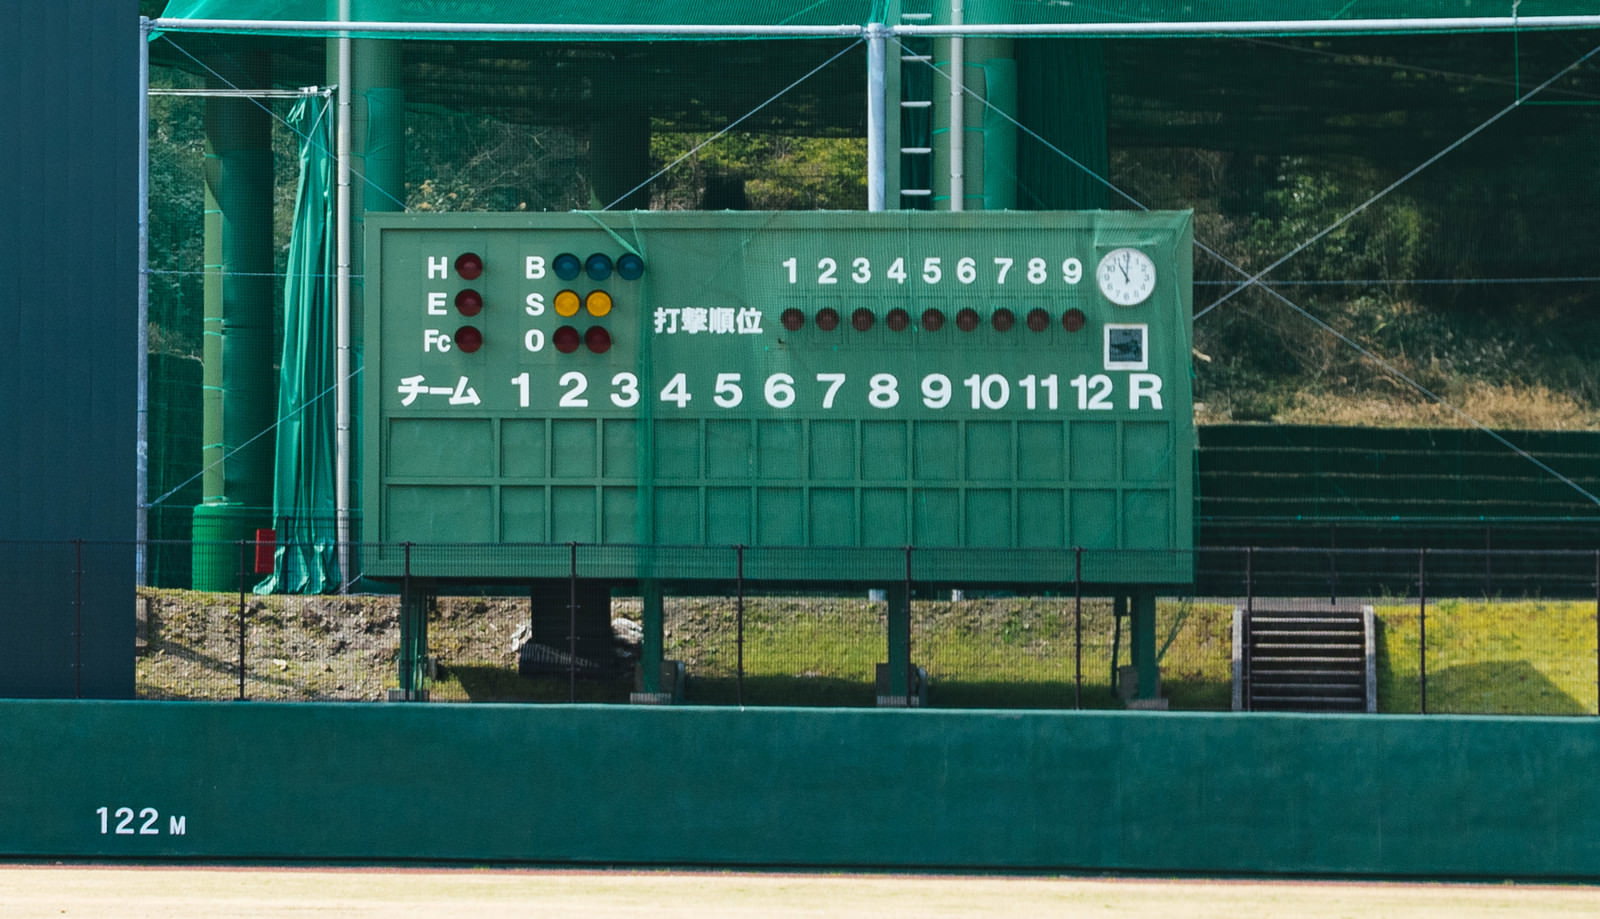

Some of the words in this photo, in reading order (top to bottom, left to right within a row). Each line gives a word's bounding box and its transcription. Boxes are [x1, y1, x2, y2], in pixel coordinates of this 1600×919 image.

[427, 256, 448, 280] H
[525, 255, 546, 280] B
[782, 257, 797, 285] 1
[817, 257, 838, 285] 2
[851, 257, 872, 285] 3
[886, 257, 907, 285] 4
[922, 257, 942, 285] 5
[956, 257, 977, 285] 6
[994, 257, 1014, 285] 7
[1027, 257, 1047, 285] 8
[1062, 257, 1083, 285] 9
[427, 292, 448, 316] E
[525, 292, 545, 316] S
[654, 306, 763, 334] 打撃順位
[423, 329, 451, 353] Fc
[397, 374, 481, 407] チーム
[511, 372, 530, 409] 1
[559, 372, 589, 409] 2
[610, 372, 640, 409] 3
[660, 372, 692, 409] 4
[713, 372, 743, 409] 5
[764, 372, 796, 409] 6
[816, 372, 846, 409] 7
[868, 372, 900, 409] 8
[921, 372, 952, 409] 9
[963, 372, 1010, 410] 10
[1018, 373, 1058, 410] 11
[1070, 373, 1113, 410] 12
[1128, 373, 1163, 410] R
[96, 806, 160, 835] 122
[169, 815, 187, 836] M
